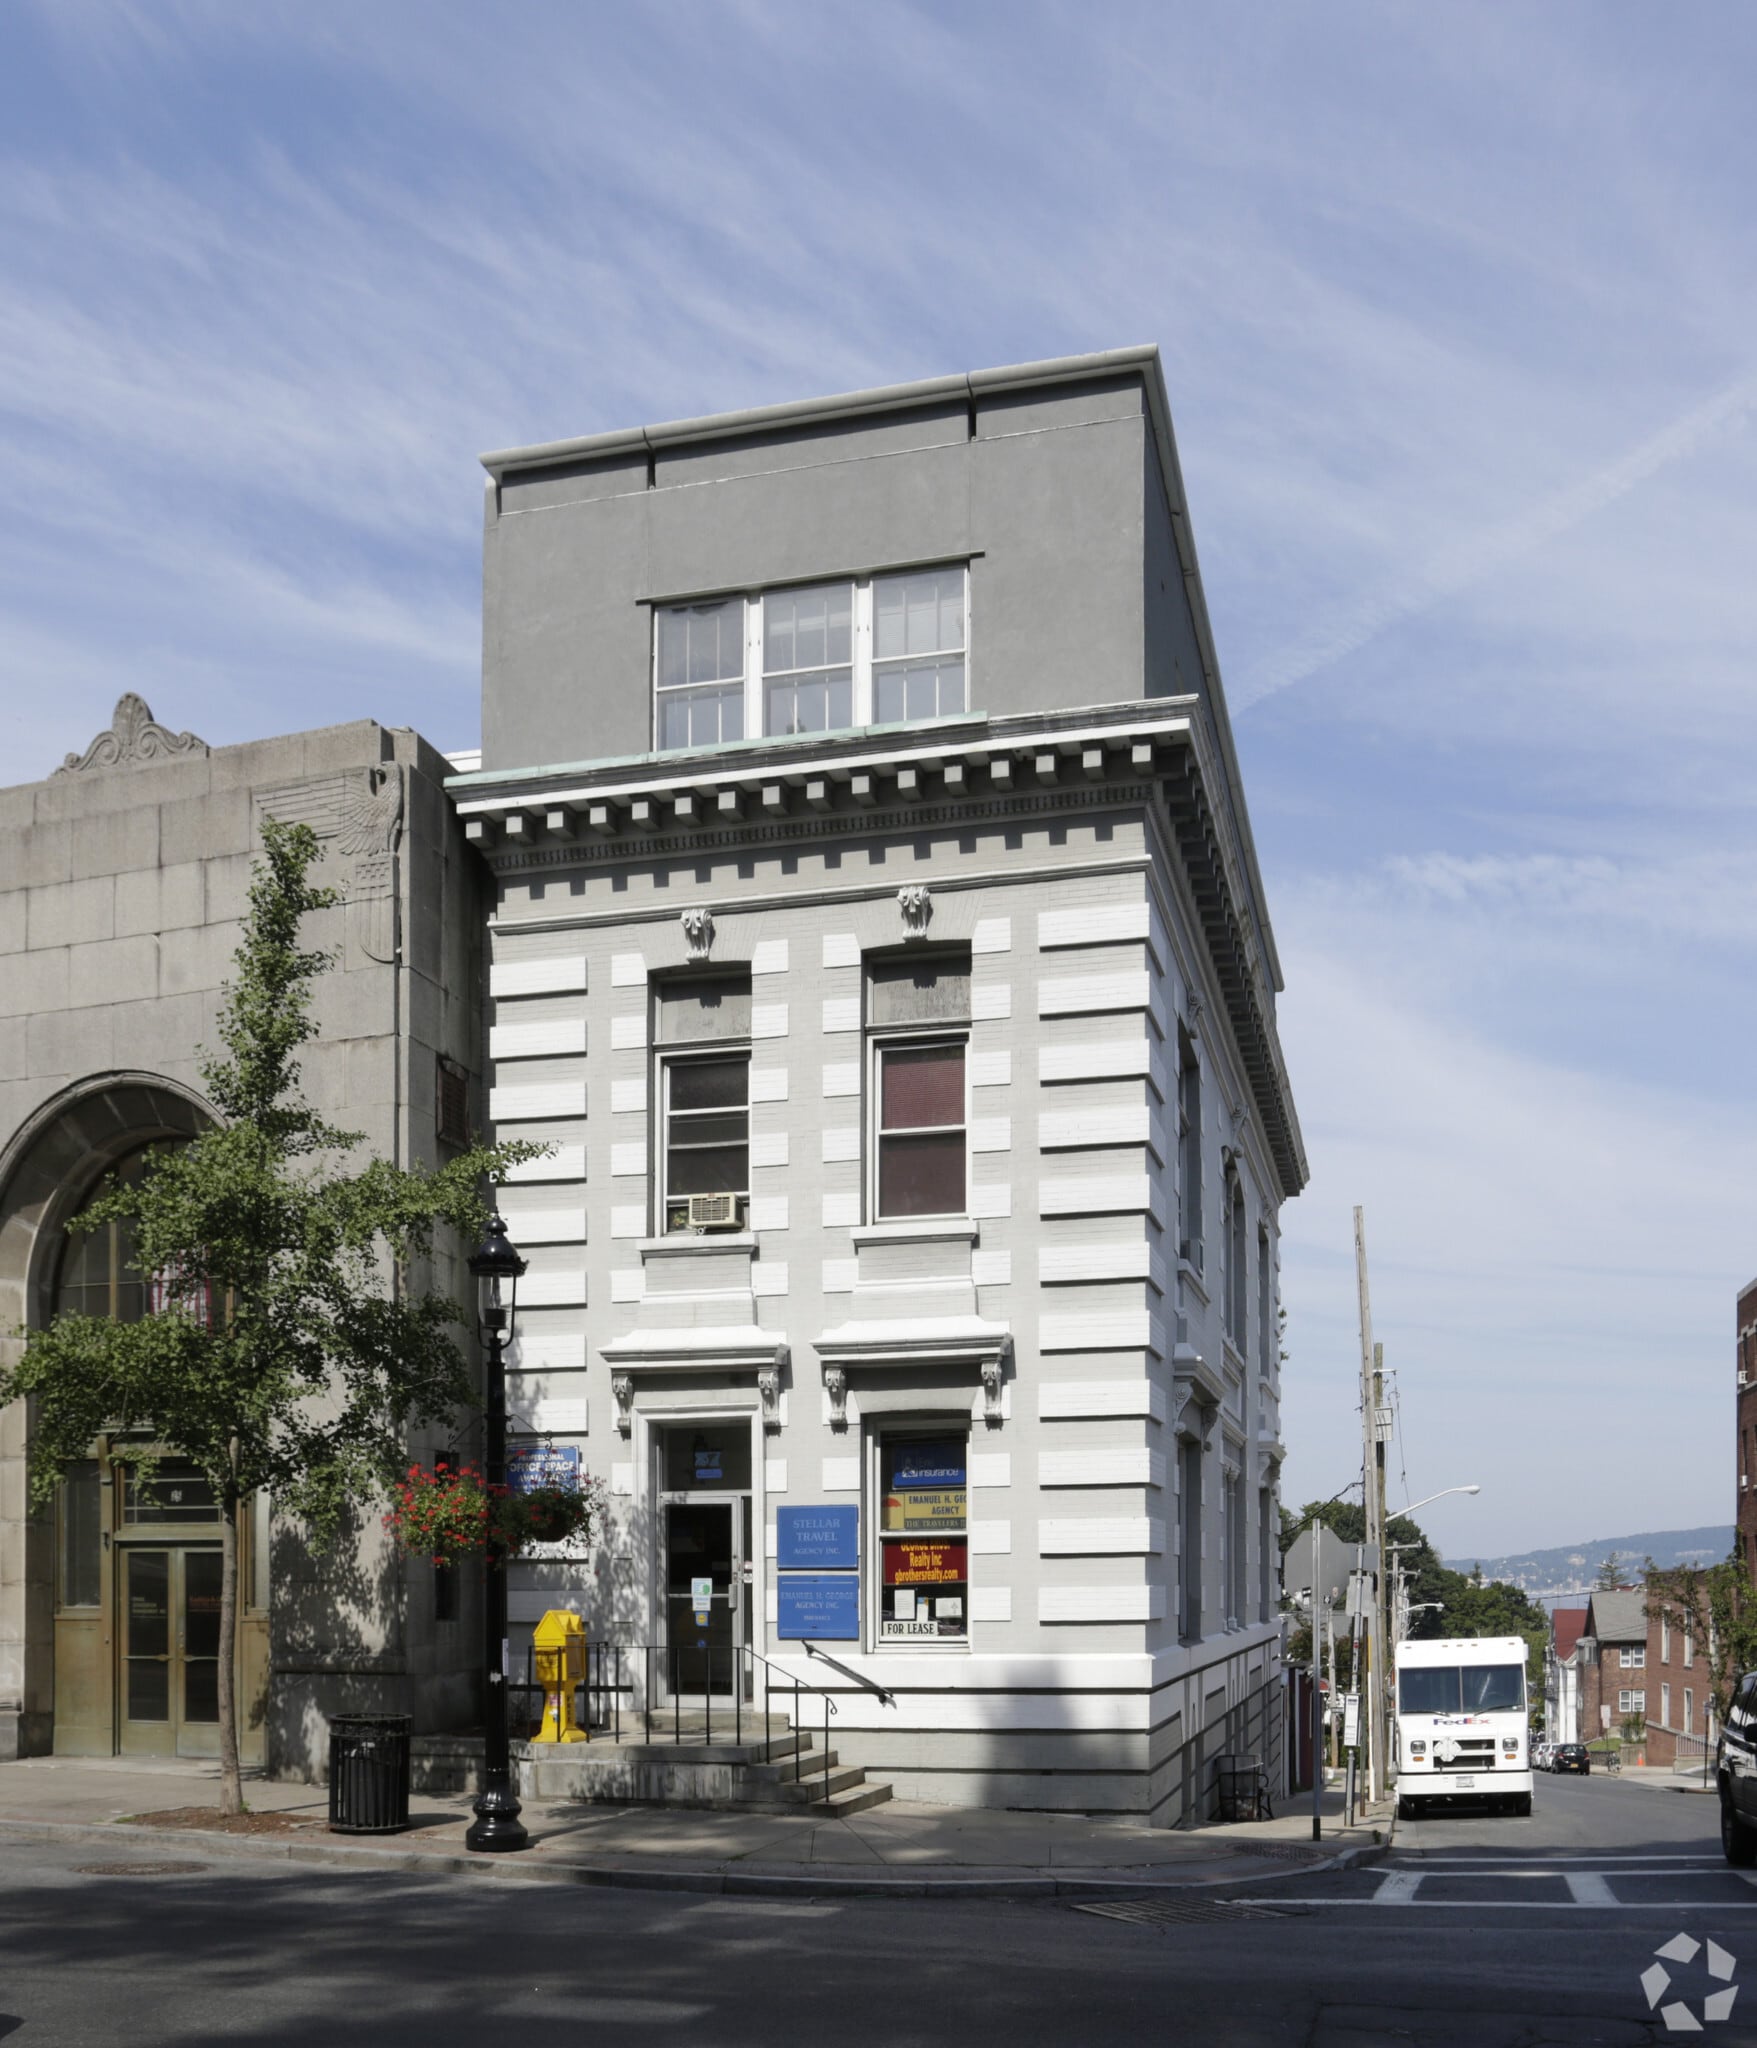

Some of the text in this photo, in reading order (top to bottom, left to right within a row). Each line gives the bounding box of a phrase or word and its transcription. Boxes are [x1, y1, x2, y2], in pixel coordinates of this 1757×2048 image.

[510, 1461, 575, 1472] OFFICE SPACE
[908, 1495, 941, 1504] EMANUEL
[931, 1506, 960, 1515] AGENCY
[793, 1518, 840, 1529] STELLAR
[796, 1532, 838, 1541] TRAVEL
[793, 1547, 824, 1555] AGENCY
[909, 1551, 931, 1570] Realty
[795, 1601, 824, 1609] AGENCY
[887, 1623, 935, 1635] FOR LEASE
[1433, 1717, 1491, 1726] FedEx
